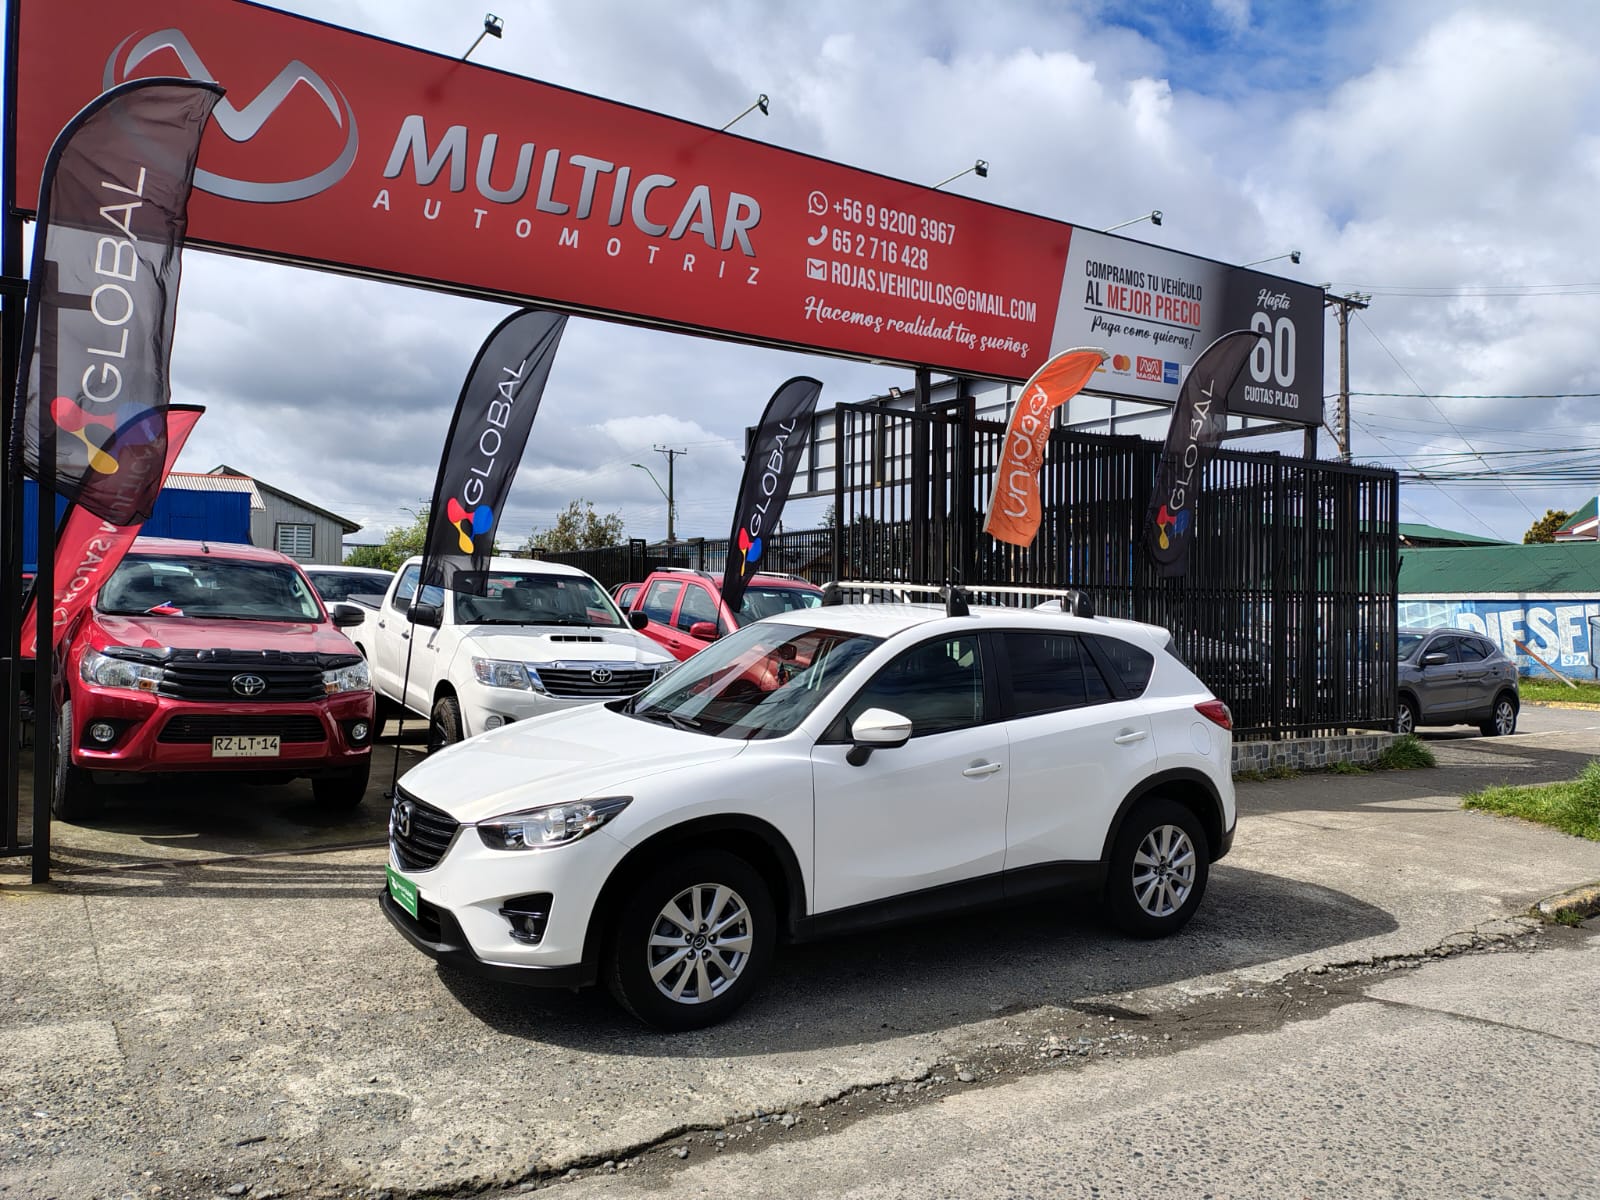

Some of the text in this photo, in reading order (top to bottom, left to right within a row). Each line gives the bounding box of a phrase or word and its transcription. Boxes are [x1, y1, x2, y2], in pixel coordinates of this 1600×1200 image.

[382, 114, 762, 258] MULTICAR
[371, 188, 760, 286] AUTOMOTRIZ
[832, 198, 956, 246] +56 9 9200 3967
[832, 228, 929, 271] 65 2 716 428
[81, 166, 146, 403] GLOBAL
[831, 261, 1037, 323] ROJAS.VEHICULOS@GMAIL.COM
[1085, 260, 1202, 301] COMPRAMOS TU VEHÍCULO
[1085, 280, 1201, 326] AL MEJOR PRECIO
[1257, 288, 1291, 311] Hasta
[804, 295, 1030, 358] Hacemos realidad tus sueños
[1091, 315, 1195, 350] Paga como quieras!
[1249, 311, 1296, 388] 60
[1137, 372, 1161, 380] MAGNA
[1244, 385, 1299, 409] CUOTAS PLAZO
[463, 359, 527, 505] GLOBAL
[1170, 379, 1215, 511] GLOBAL
[750, 418, 797, 537] GLOBAL
[1564, 655, 1587, 665] SPA
